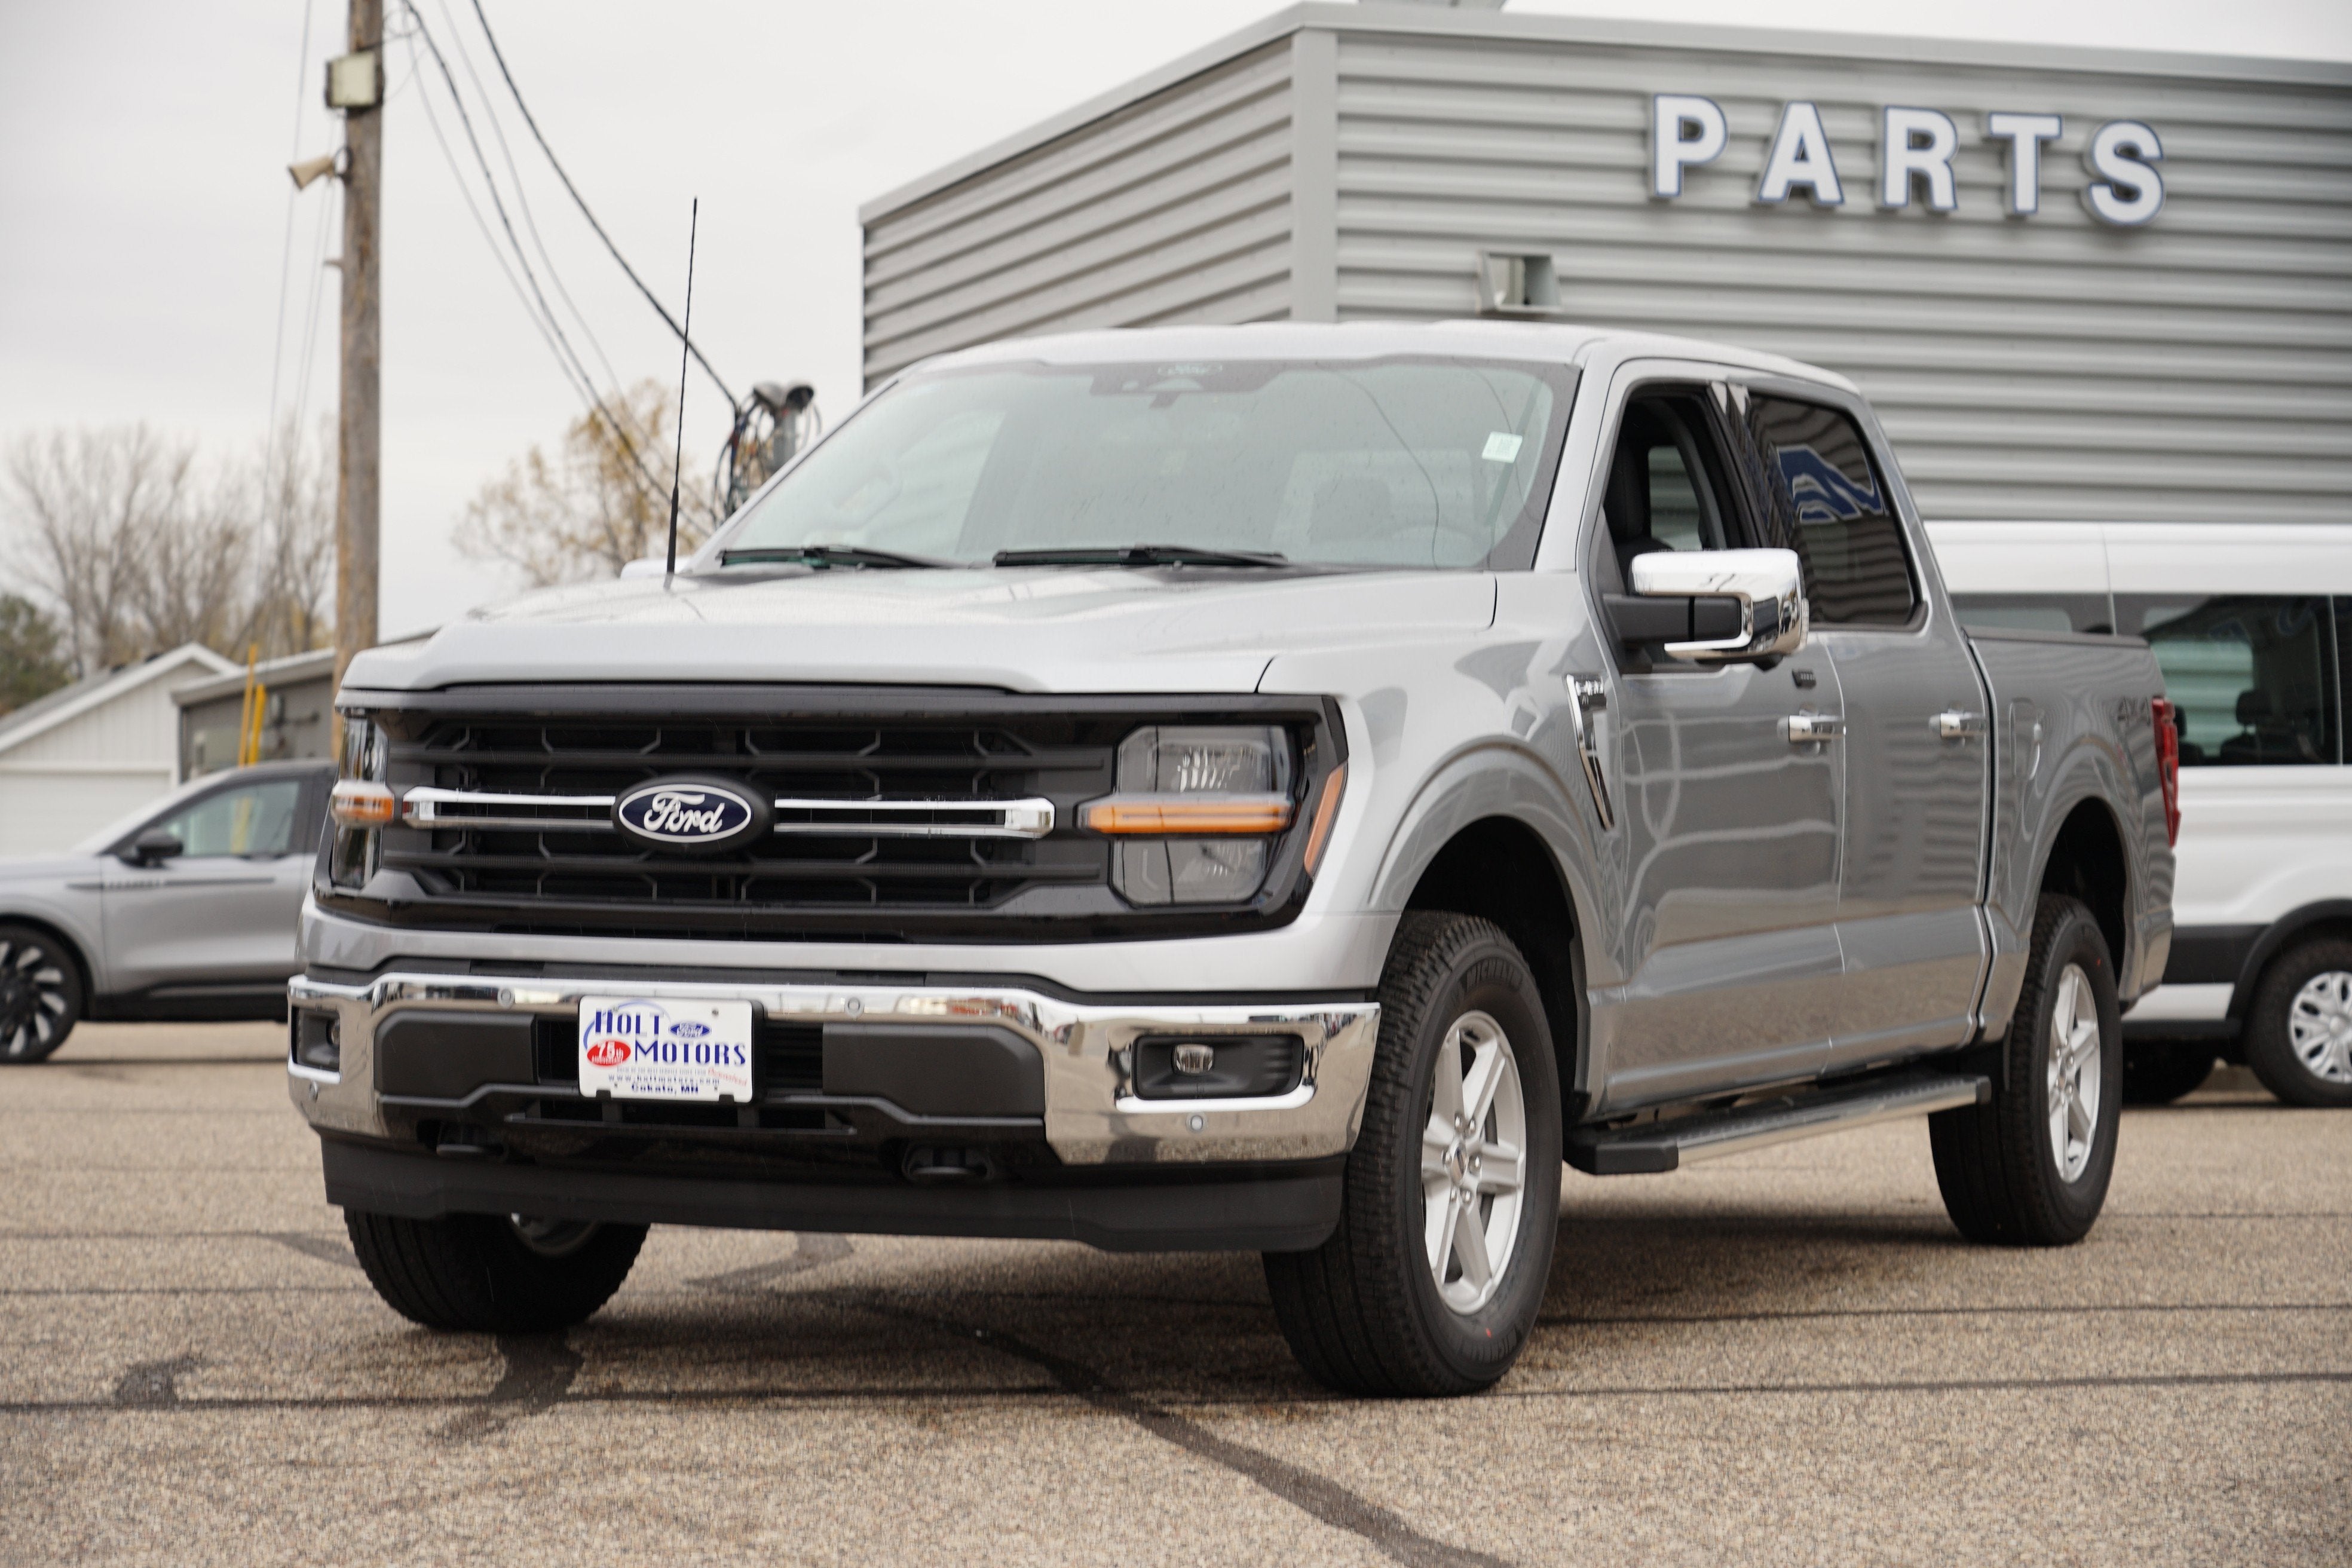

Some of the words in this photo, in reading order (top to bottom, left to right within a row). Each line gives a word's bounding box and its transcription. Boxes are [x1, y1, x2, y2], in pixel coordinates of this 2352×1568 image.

[1653, 93, 2165, 225] PARTS
[644, 791, 725, 834] Ford
[595, 1008, 664, 1037] HOLT
[597, 1040, 624, 1061] 75th
[635, 1039, 746, 1066] MOTORS
[681, 1083, 699, 1094] MN
